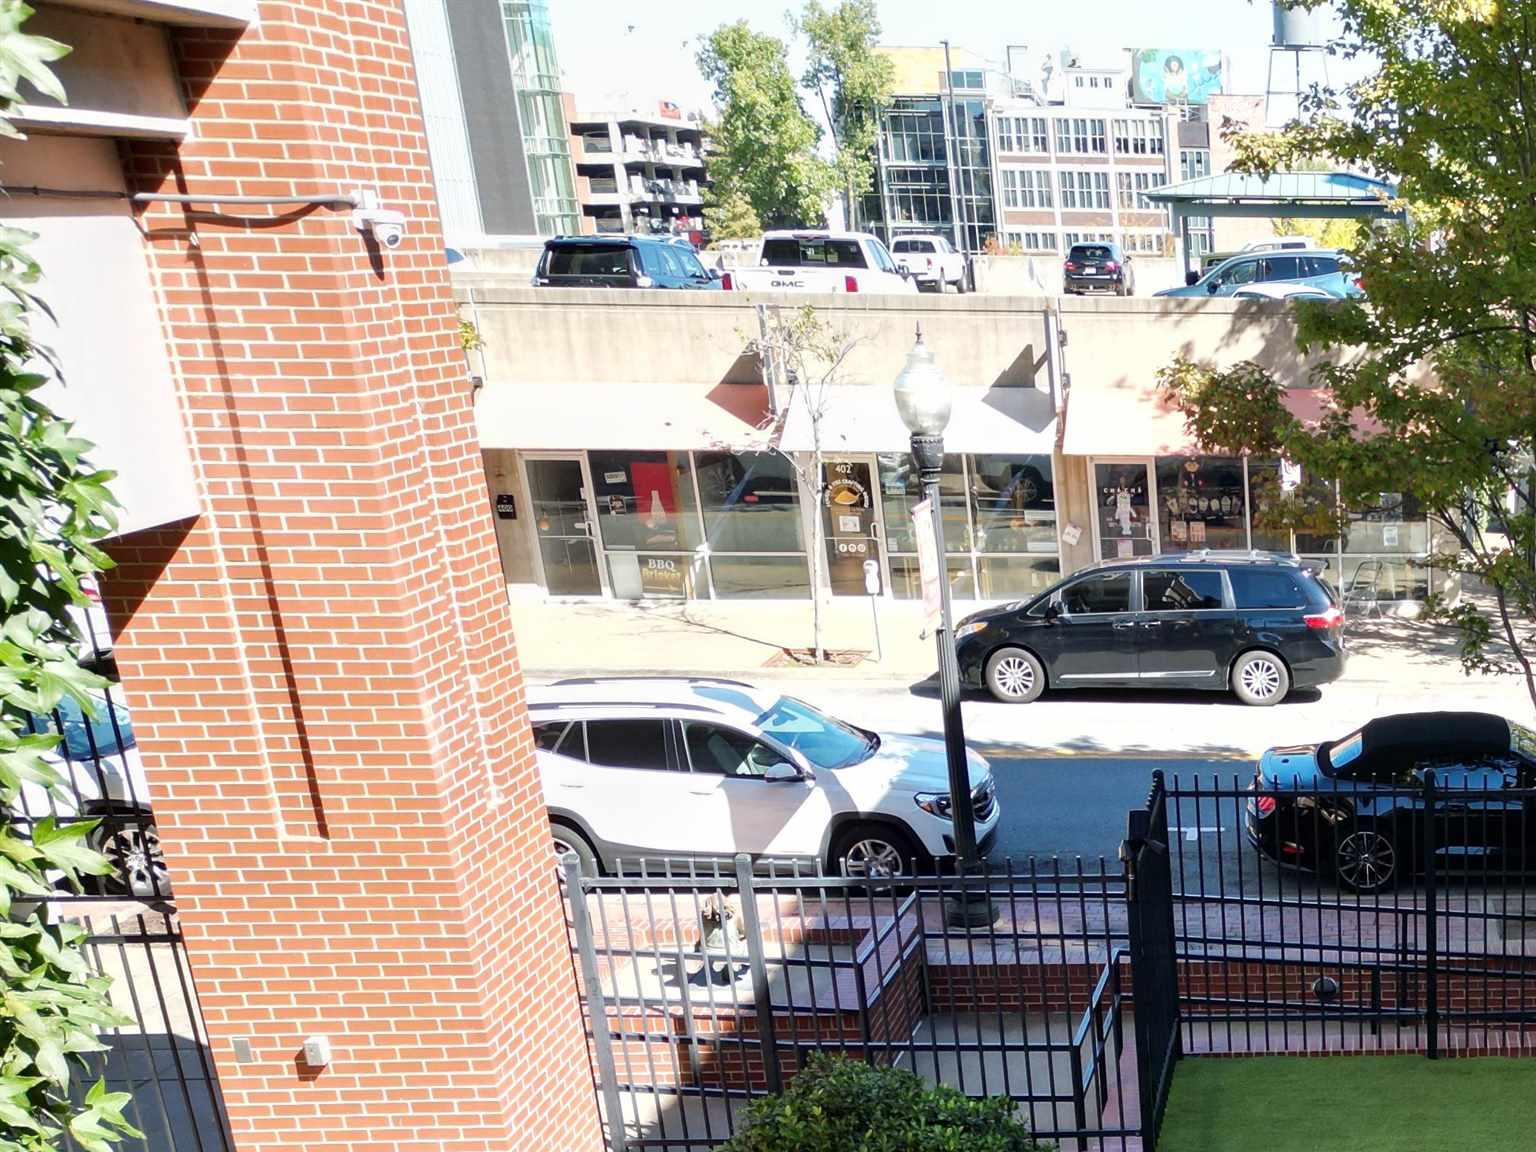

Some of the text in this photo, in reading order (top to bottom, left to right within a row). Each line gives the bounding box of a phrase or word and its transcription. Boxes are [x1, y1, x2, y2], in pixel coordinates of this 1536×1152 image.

[770, 280, 806, 288] GMC
[834, 463, 853, 474] 402
[648, 558, 674, 570] BBQ
